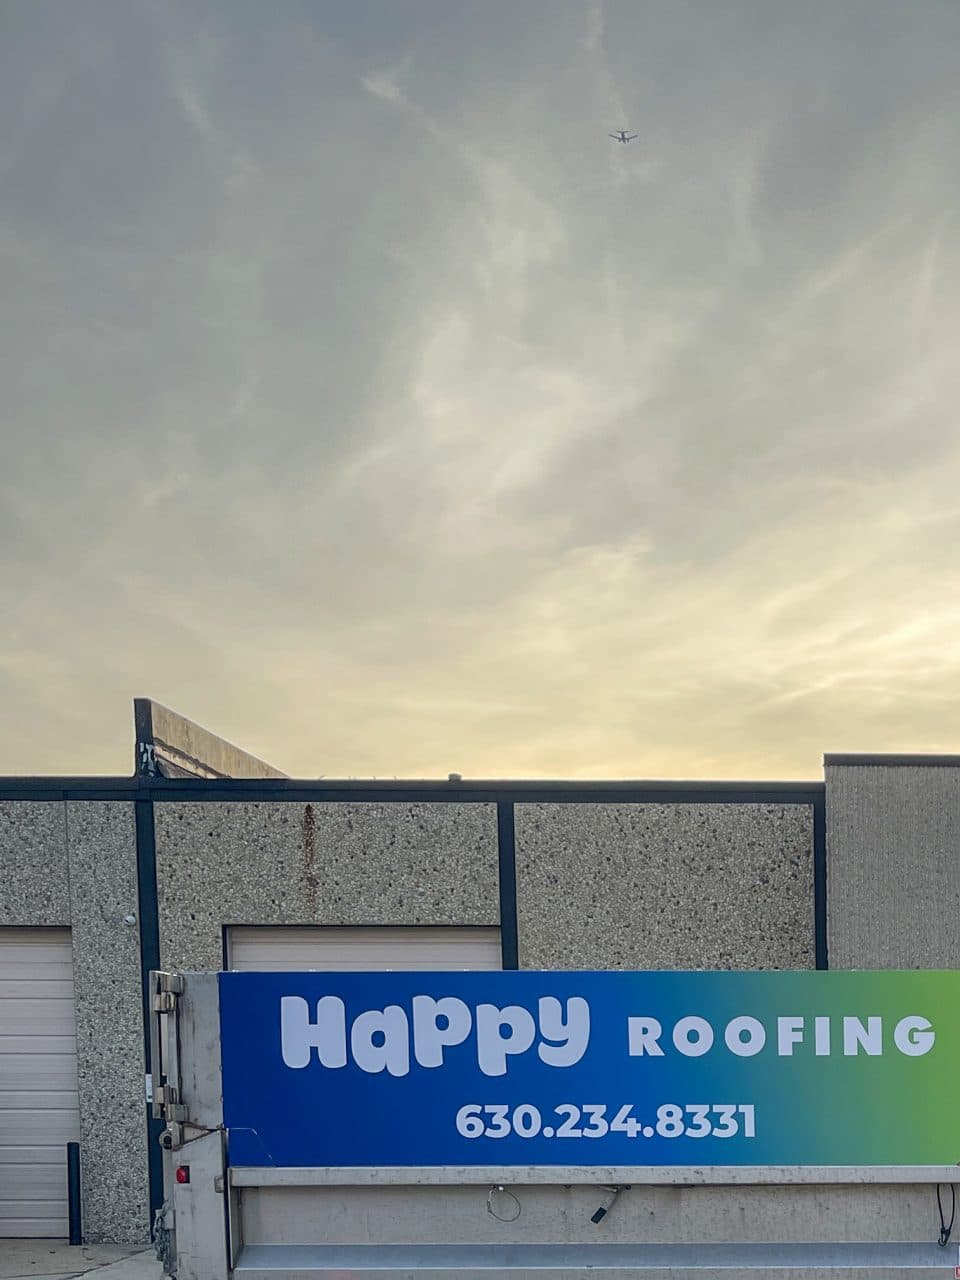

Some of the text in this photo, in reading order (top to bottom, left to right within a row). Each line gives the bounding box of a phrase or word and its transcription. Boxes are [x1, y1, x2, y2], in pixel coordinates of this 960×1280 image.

[281, 996, 936, 1077] Happy ROOFING
[456, 1104, 756, 1138] 630.234.8331
